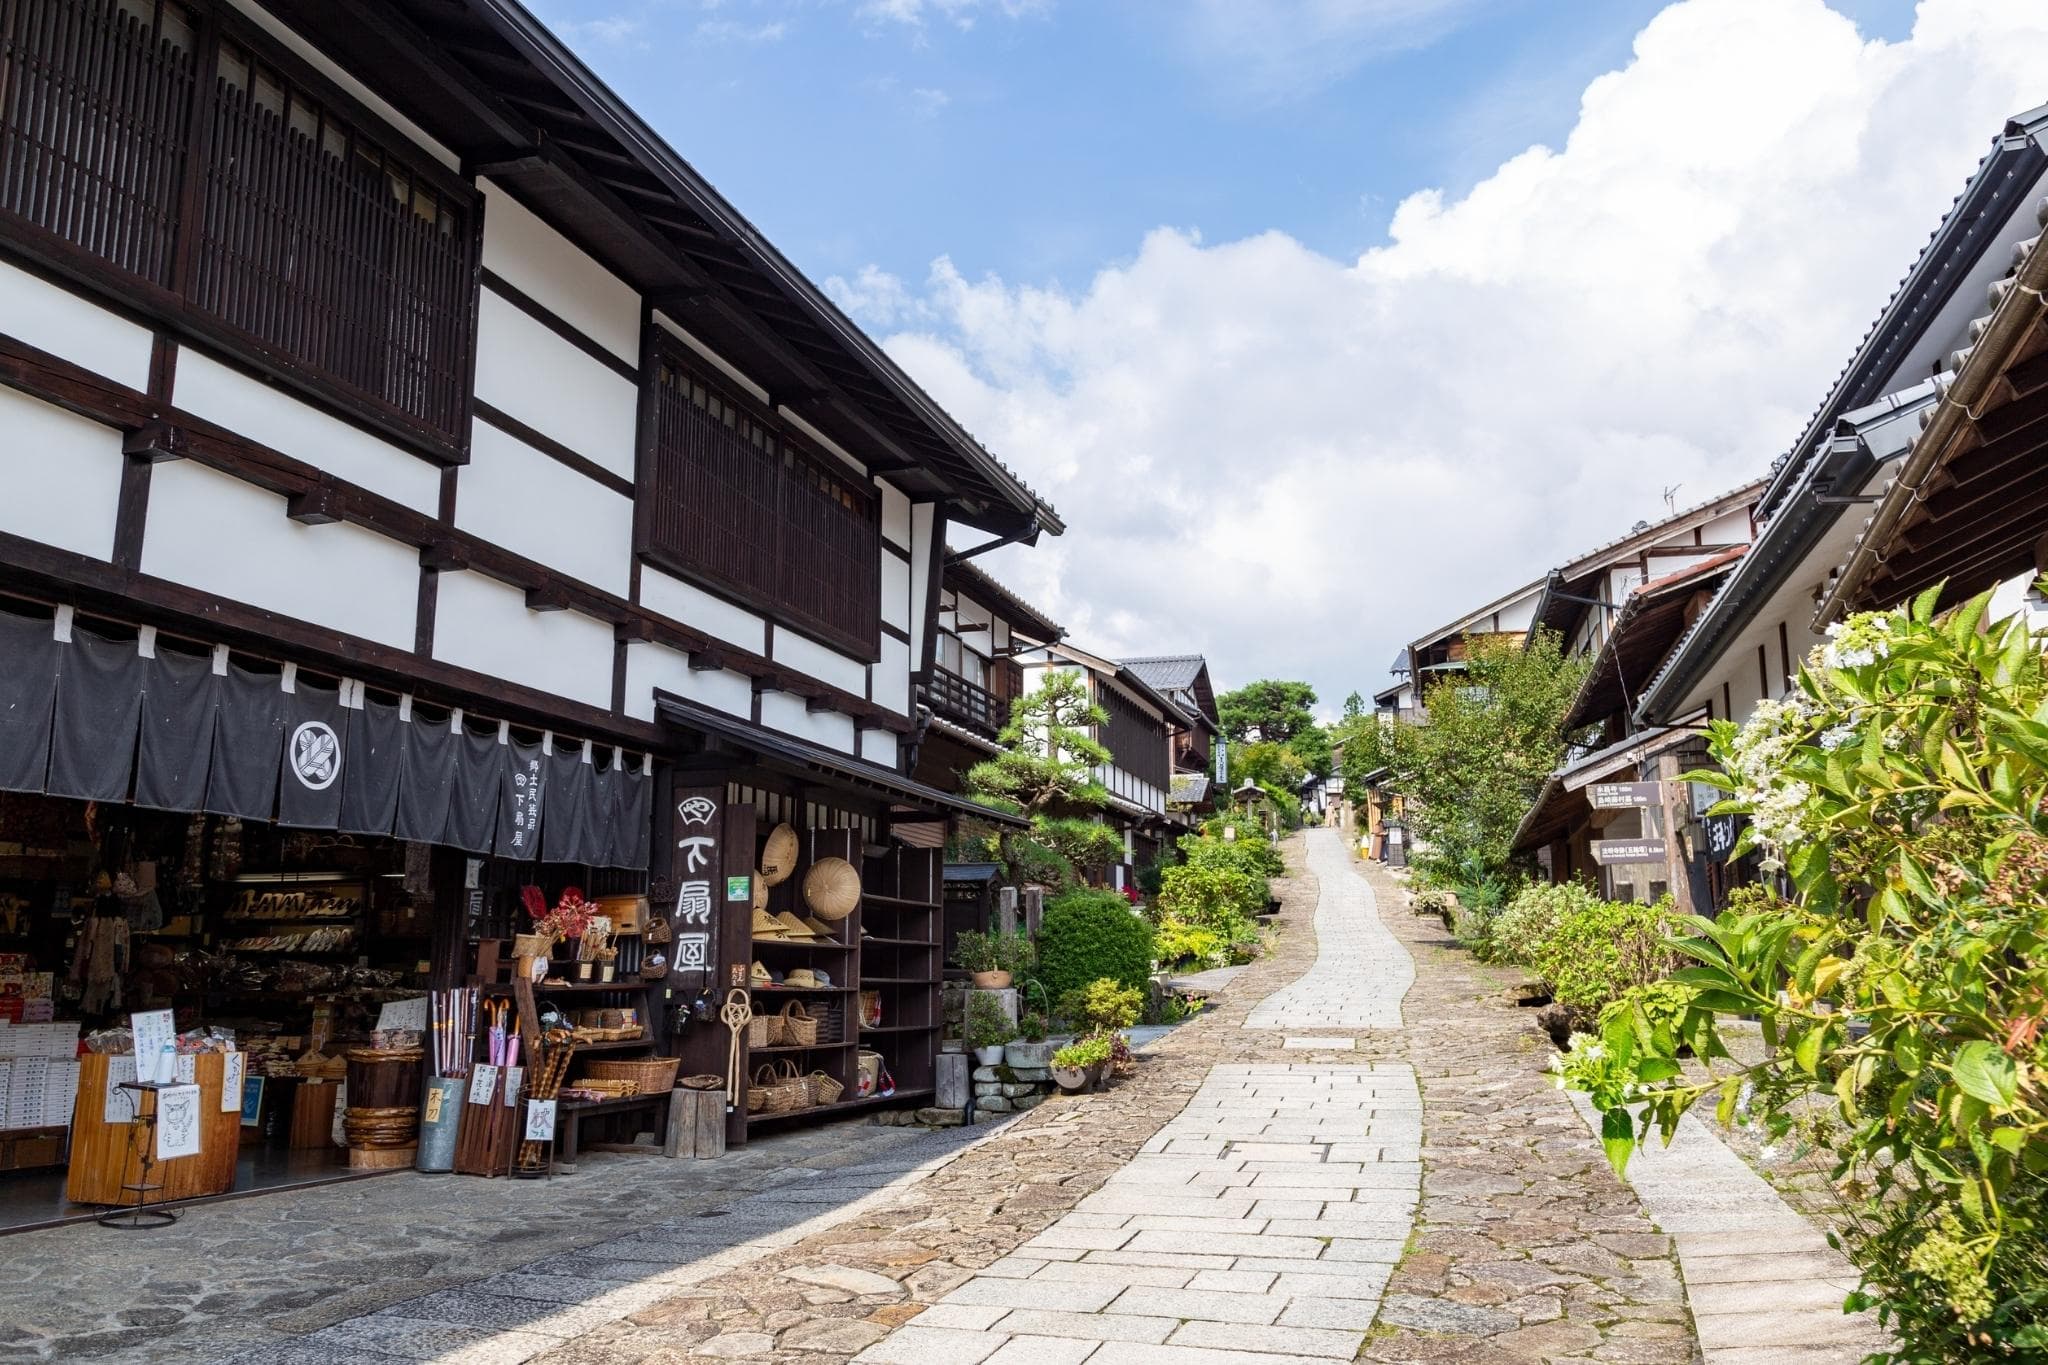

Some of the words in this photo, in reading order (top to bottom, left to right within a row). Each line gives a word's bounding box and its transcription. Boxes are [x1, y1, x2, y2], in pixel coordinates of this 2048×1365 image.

[528, 760, 539, 831] 郷土民芸品
[428, 1090, 440, 1120] 木刀
